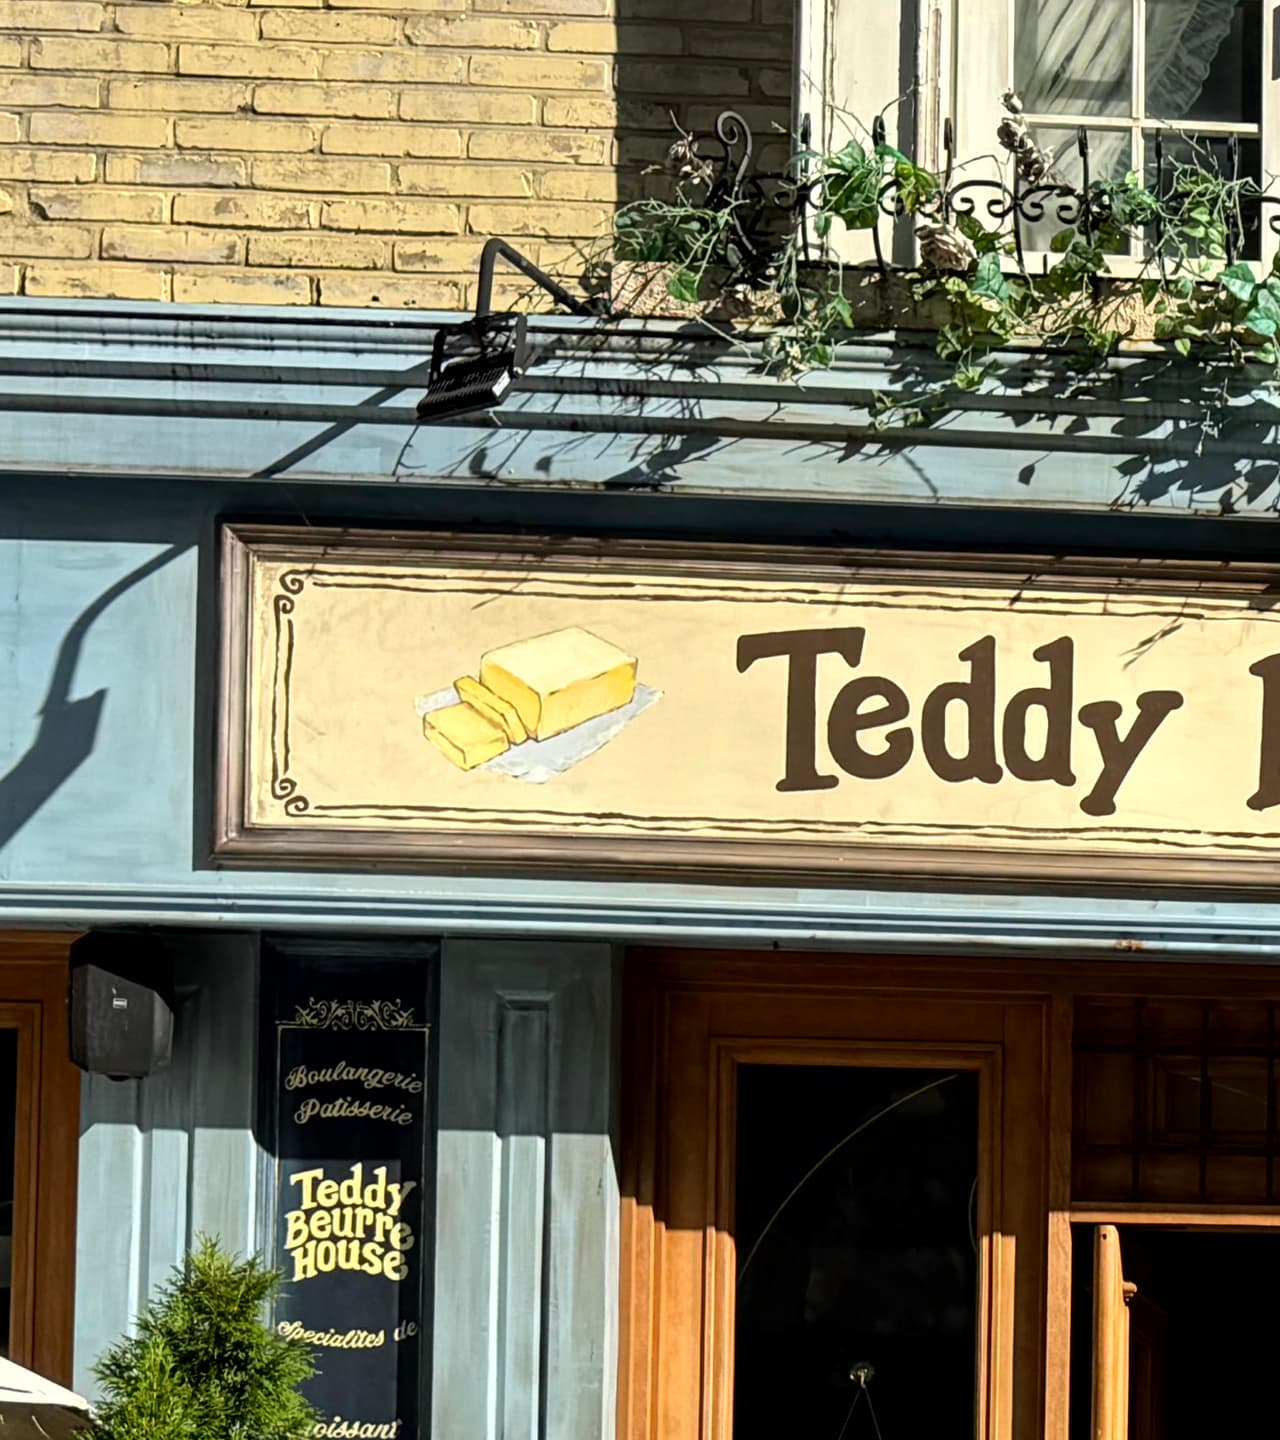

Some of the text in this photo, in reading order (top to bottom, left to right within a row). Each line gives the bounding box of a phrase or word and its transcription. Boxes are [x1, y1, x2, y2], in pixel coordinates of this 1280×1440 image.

[736, 627, 1184, 816] Teddy
[285, 1060, 424, 1094] Boulangerie
[294, 1096, 413, 1126] Patisserie
[289, 1162, 417, 1216] Teddy
[284, 1206, 415, 1250] Beurre
[393, 1319, 418, 1342] de
